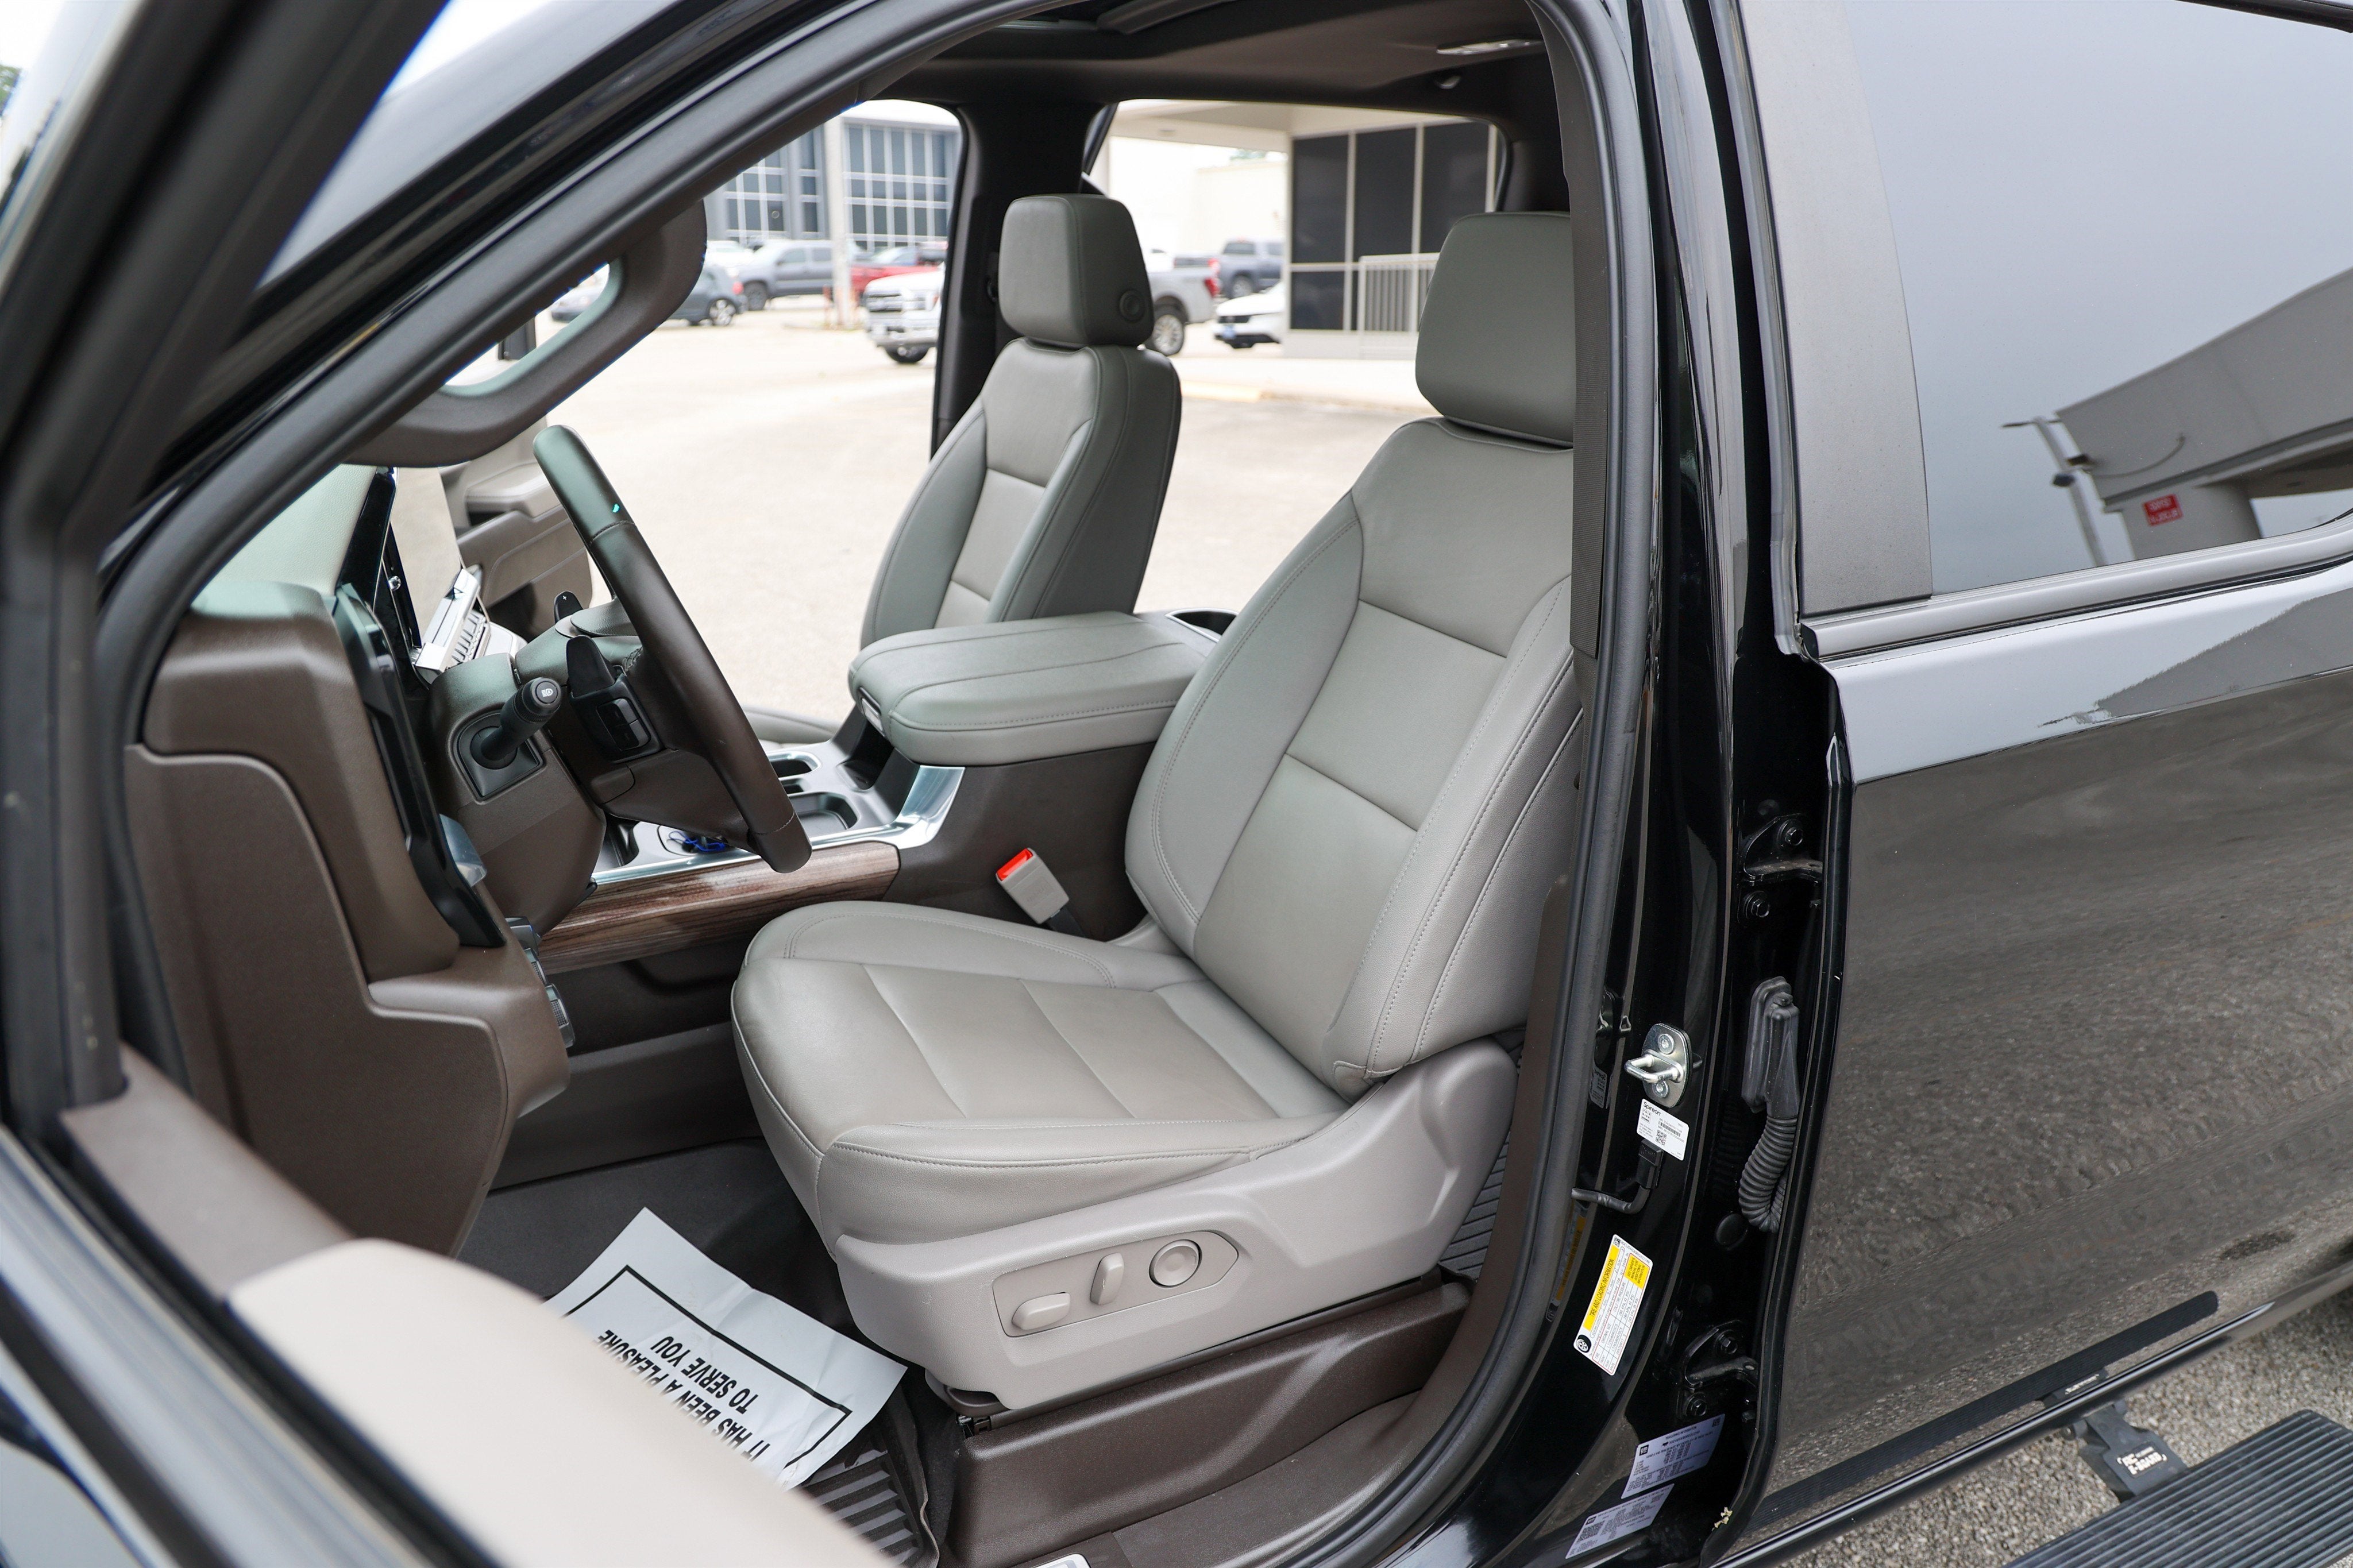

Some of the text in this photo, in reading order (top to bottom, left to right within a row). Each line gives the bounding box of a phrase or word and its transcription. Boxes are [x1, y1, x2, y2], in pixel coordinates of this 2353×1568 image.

[1644, 1102, 1661, 1115] Spireon
[1596, 1283, 1606, 1301] LOADING
[1603, 1258, 1614, 1284] INFORMATION
[595, 1330, 770, 1462] IT HAS BEEN A PLEASURE
[650, 1337, 758, 1414] TO SERVE YOU
